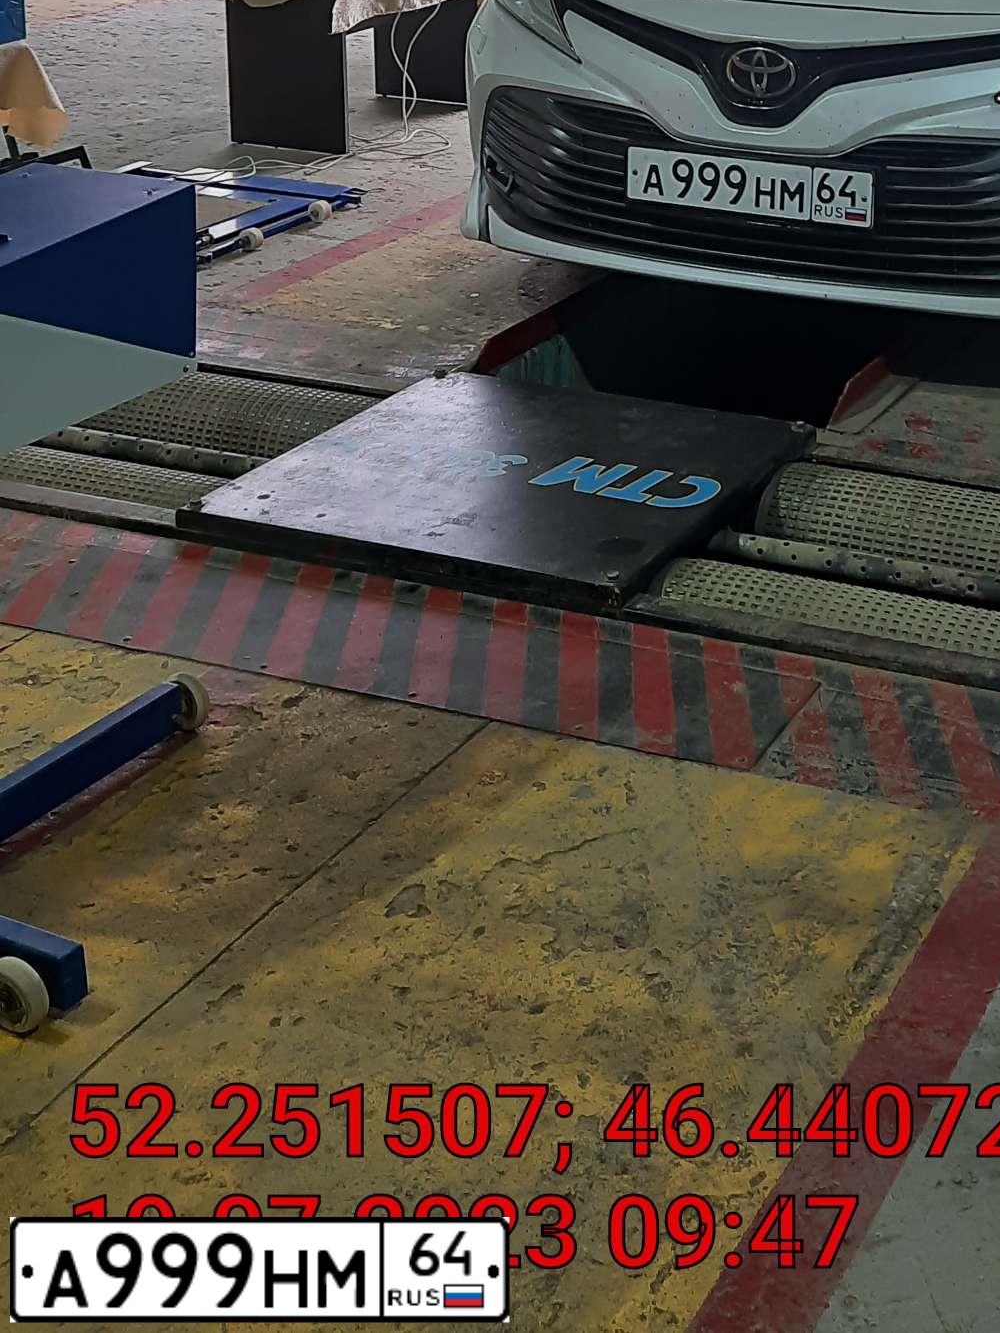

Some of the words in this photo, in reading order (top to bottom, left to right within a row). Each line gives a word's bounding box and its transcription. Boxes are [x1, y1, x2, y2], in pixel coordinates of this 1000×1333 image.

[642, 158, 805, 213] А999НМ
[816, 172, 857, 207] 64
[814, 205, 843, 218] RUS
